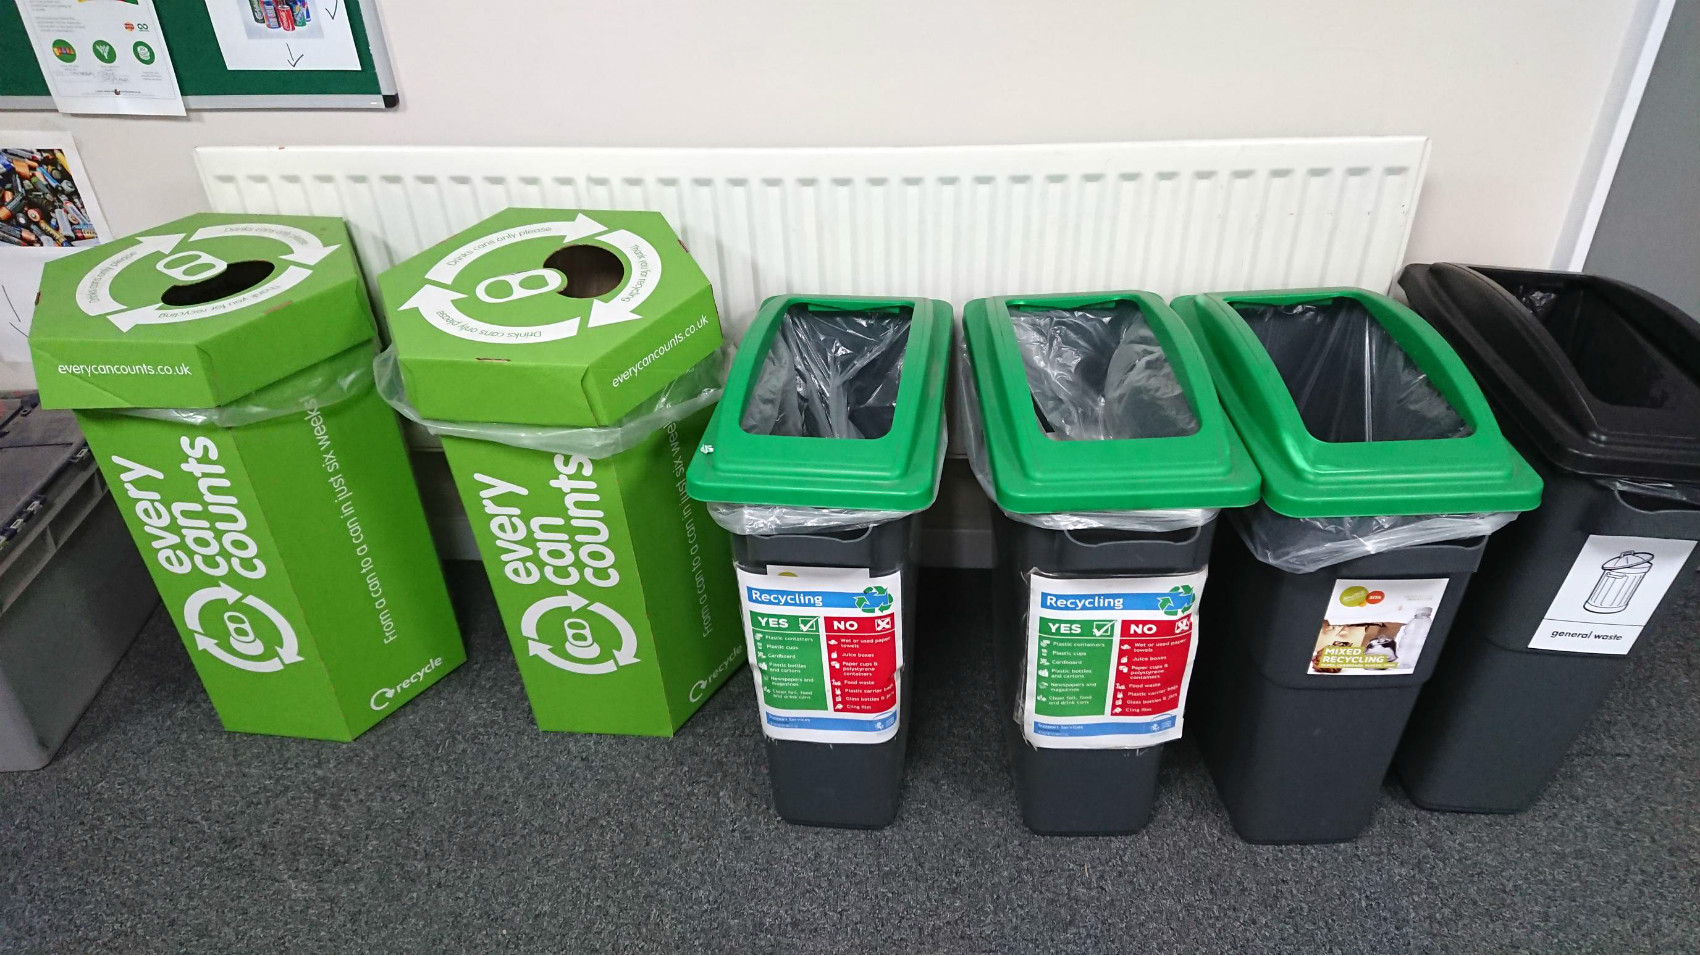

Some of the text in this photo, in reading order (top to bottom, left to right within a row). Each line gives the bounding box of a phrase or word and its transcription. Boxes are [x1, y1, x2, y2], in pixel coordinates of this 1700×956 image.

[446, 226, 552, 266] Drinks cans only please
[158, 308, 208, 318] recycling
[507, 331, 542, 340] Drinks
[612, 314, 709, 388] everycancounts.co.uk
[58, 363, 192, 377] everycancounts.co.uk
[322, 450, 339, 474] six
[672, 456, 684, 478] six
[328, 473, 352, 503] just
[111, 455, 192, 574] every
[180, 436, 267, 579] counts
[340, 500, 354, 518] in
[346, 517, 364, 544] can
[473, 472, 541, 585] every
[549, 454, 620, 588] counts
[686, 520, 697, 544] can
[171, 501, 230, 577] can
[356, 544, 368, 556] a
[690, 544, 698, 556] a
[530, 516, 580, 586] can
[360, 558, 373, 574] to
[692, 556, 701, 573] to
[366, 572, 382, 598] can
[694, 569, 706, 594] can
[375, 598, 386, 609] a
[700, 594, 707, 605] a
[752, 590, 823, 607] Recycling
[1046, 596, 1124, 610] Recycling
[378, 609, 398, 645] From
[702, 606, 713, 638] From
[758, 616, 789, 628] YES
[832, 620, 858, 631] NO
[1048, 623, 1082, 634] YES
[1130, 624, 1157, 634] NO
[1550, 630, 1592, 639] general
[396, 657, 442, 692] recycle
[707, 644, 742, 683] recycle
